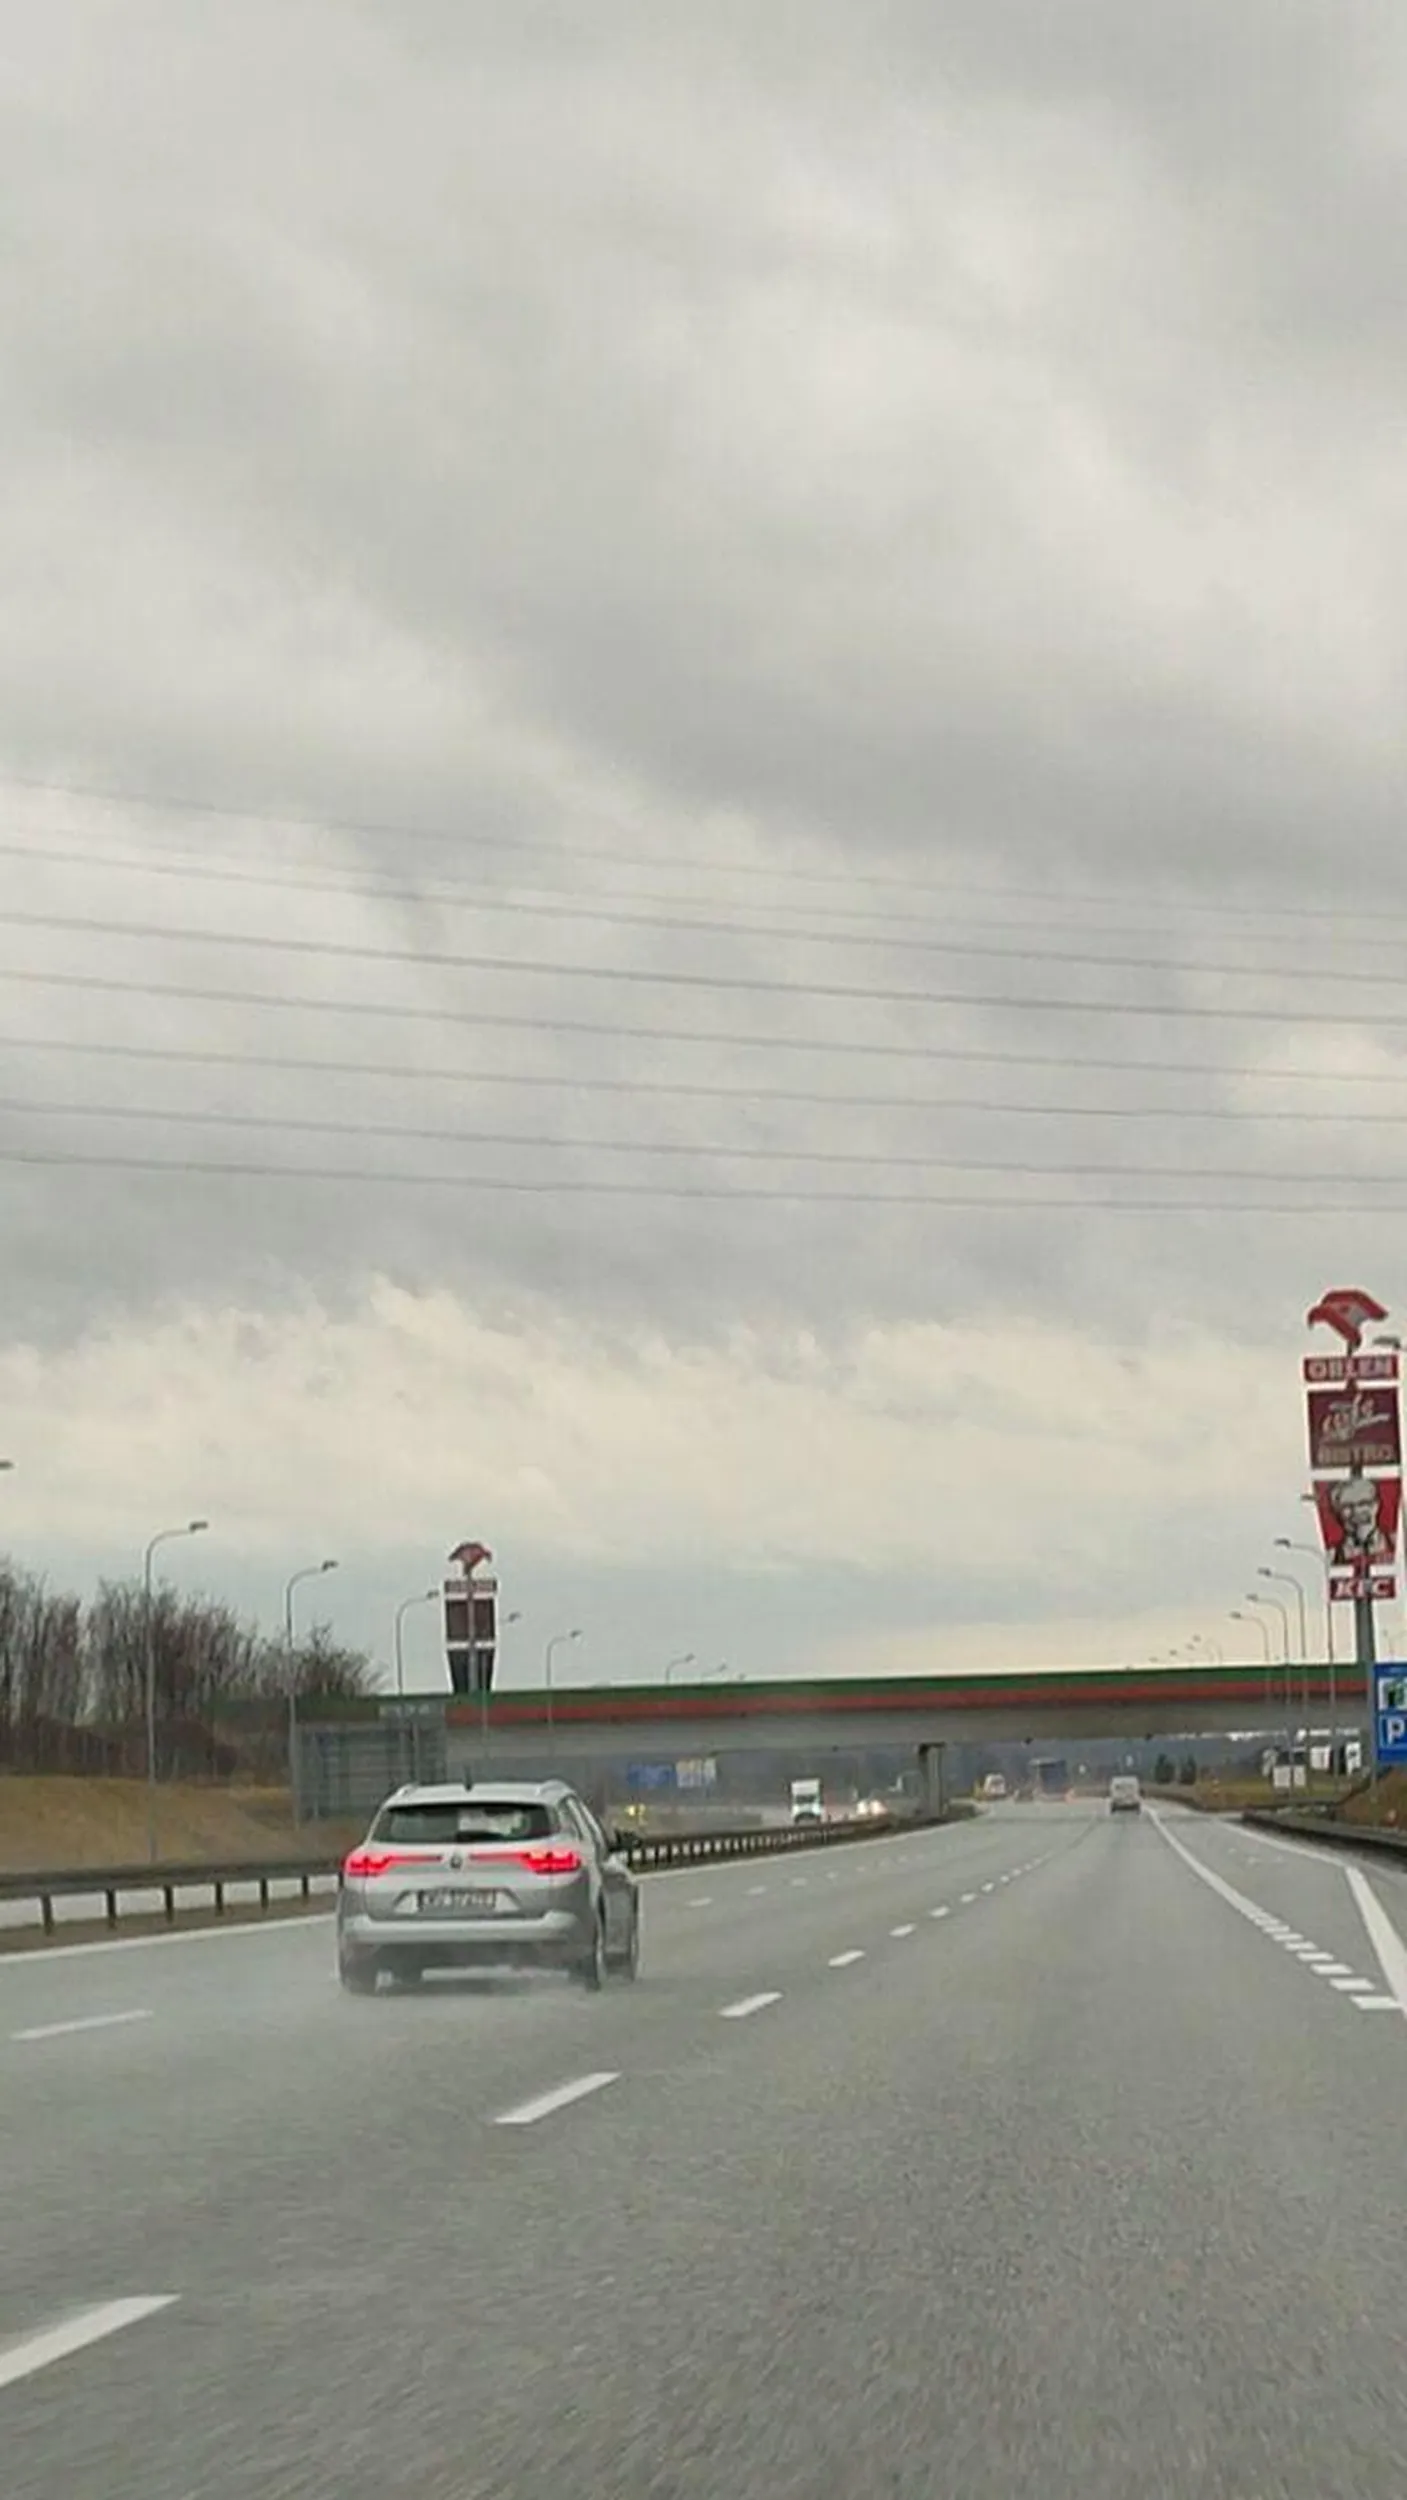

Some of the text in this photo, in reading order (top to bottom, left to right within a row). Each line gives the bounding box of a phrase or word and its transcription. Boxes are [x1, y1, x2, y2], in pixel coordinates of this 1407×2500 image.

[1308, 1360, 1392, 1380] ORLEN
[1335, 1579, 1391, 1598] KFC
[1387, 1717, 1405, 1745] P
